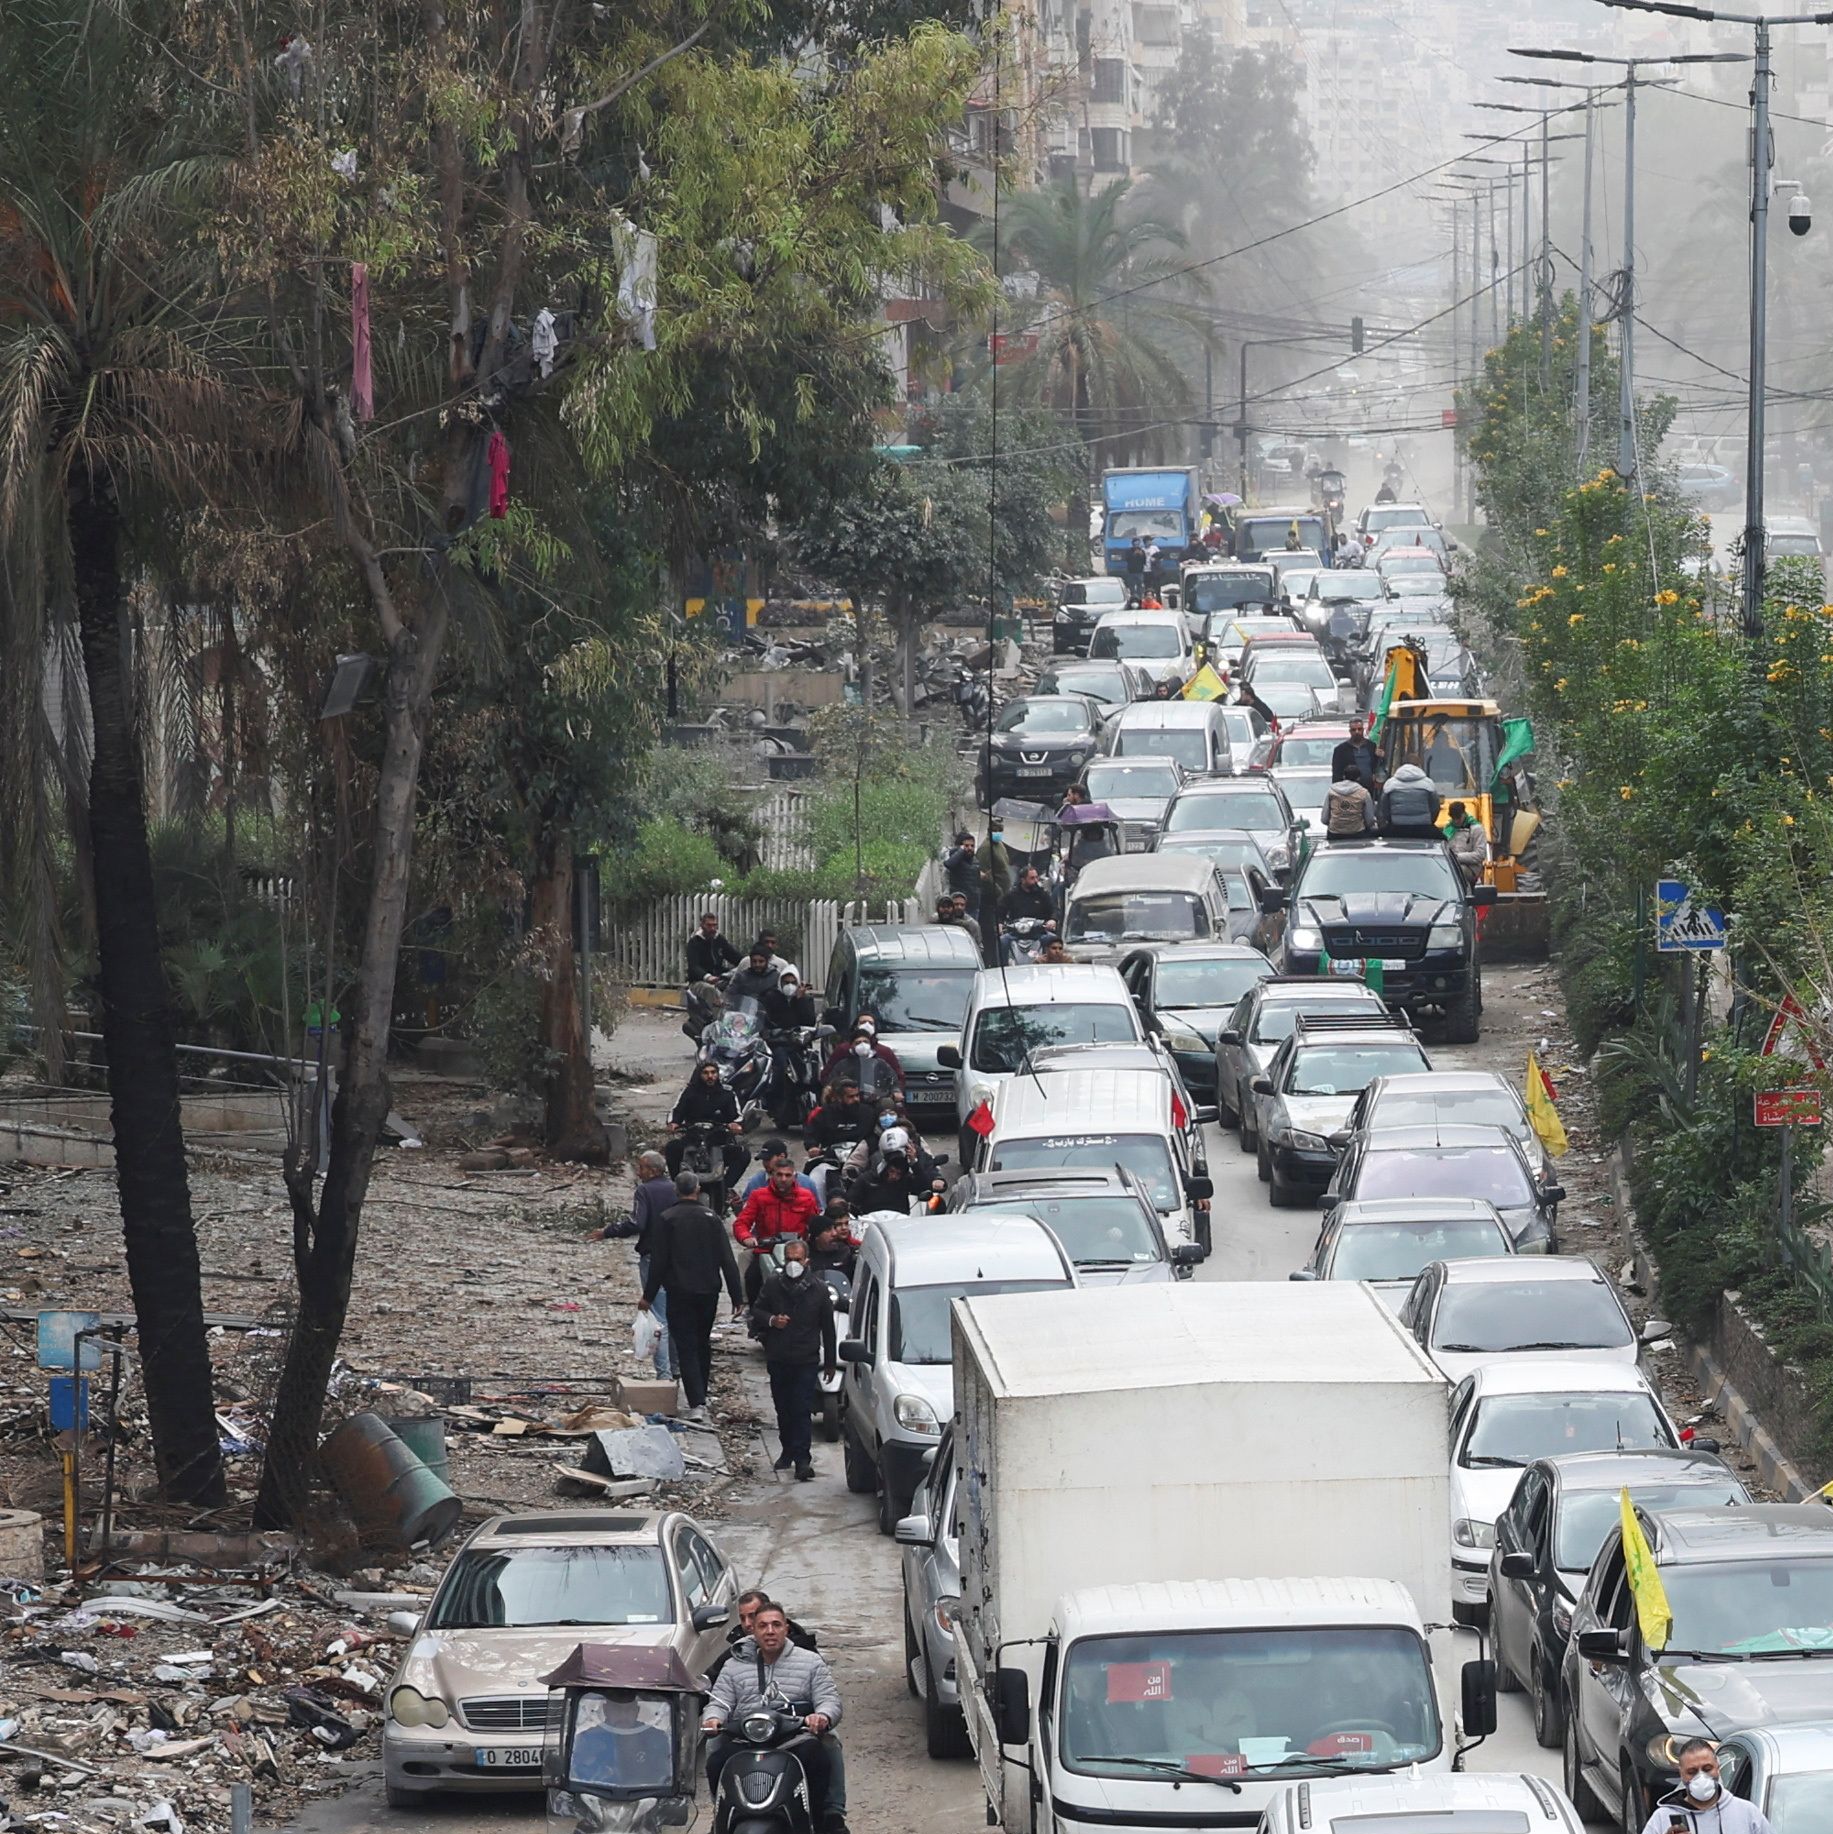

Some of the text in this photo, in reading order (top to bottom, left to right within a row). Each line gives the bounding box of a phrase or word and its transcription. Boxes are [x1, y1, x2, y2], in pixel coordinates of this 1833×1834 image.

[1144, 1686, 1161, 1697] الله
[505, 1750, 543, 1764] 2804
[1220, 1766, 1238, 1775] الله
